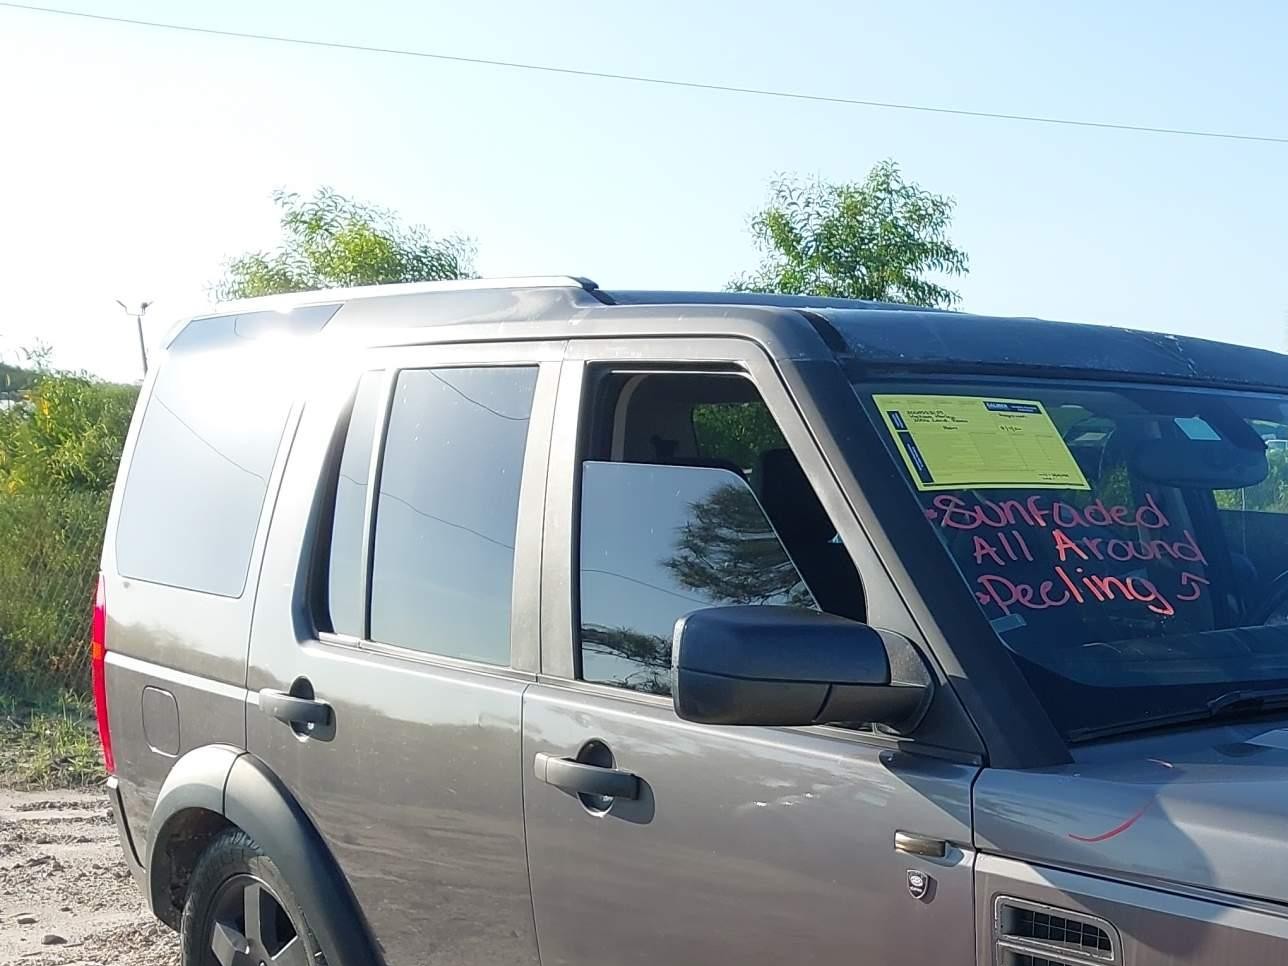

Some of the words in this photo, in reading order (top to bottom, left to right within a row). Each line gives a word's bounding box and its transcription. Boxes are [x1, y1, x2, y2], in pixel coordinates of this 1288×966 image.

[973, 530, 1034, 566] All
[1053, 528, 1209, 567] Around
[977, 566, 1175, 616] Peeling
